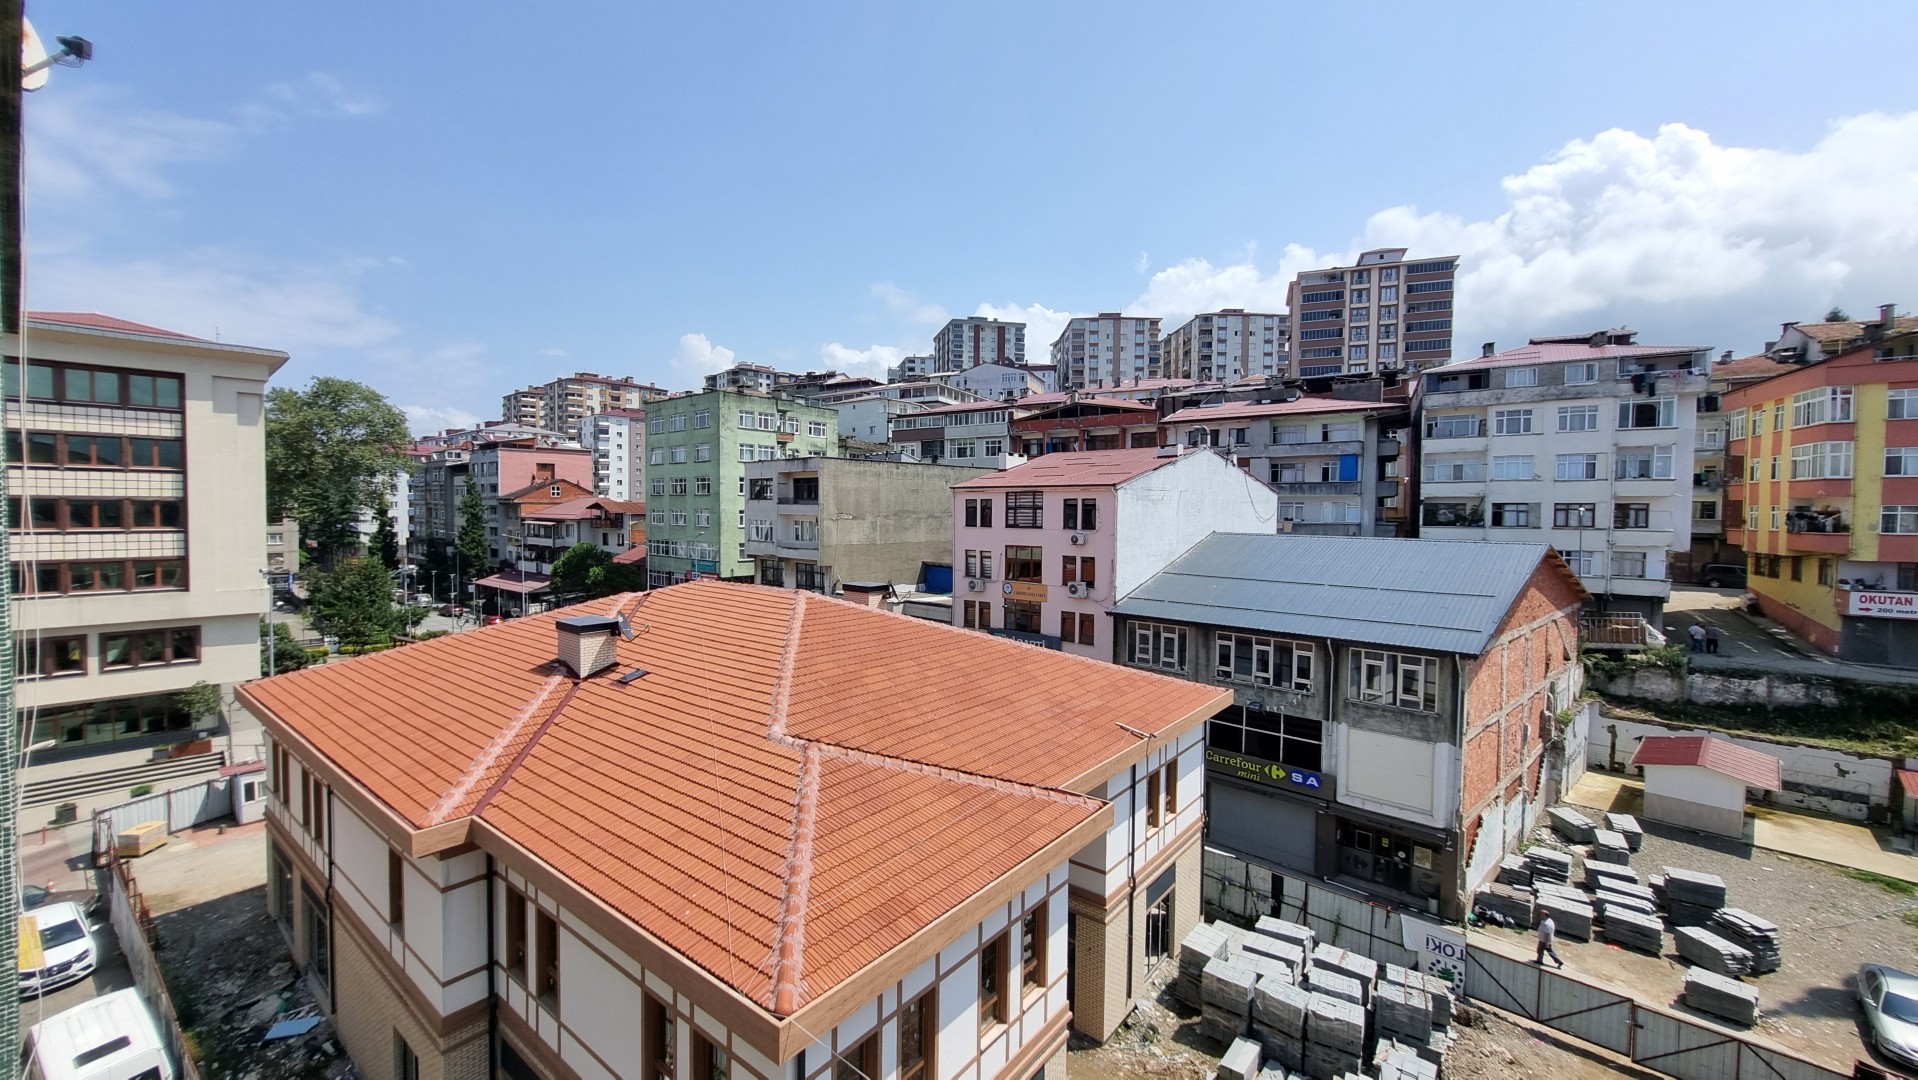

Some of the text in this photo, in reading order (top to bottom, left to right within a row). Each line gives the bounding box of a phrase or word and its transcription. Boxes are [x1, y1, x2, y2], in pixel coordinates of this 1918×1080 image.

[1859, 595, 1913, 606] OKUTAN
[1205, 750, 1262, 772] Carrefour
[1237, 769, 1261, 781] mini
